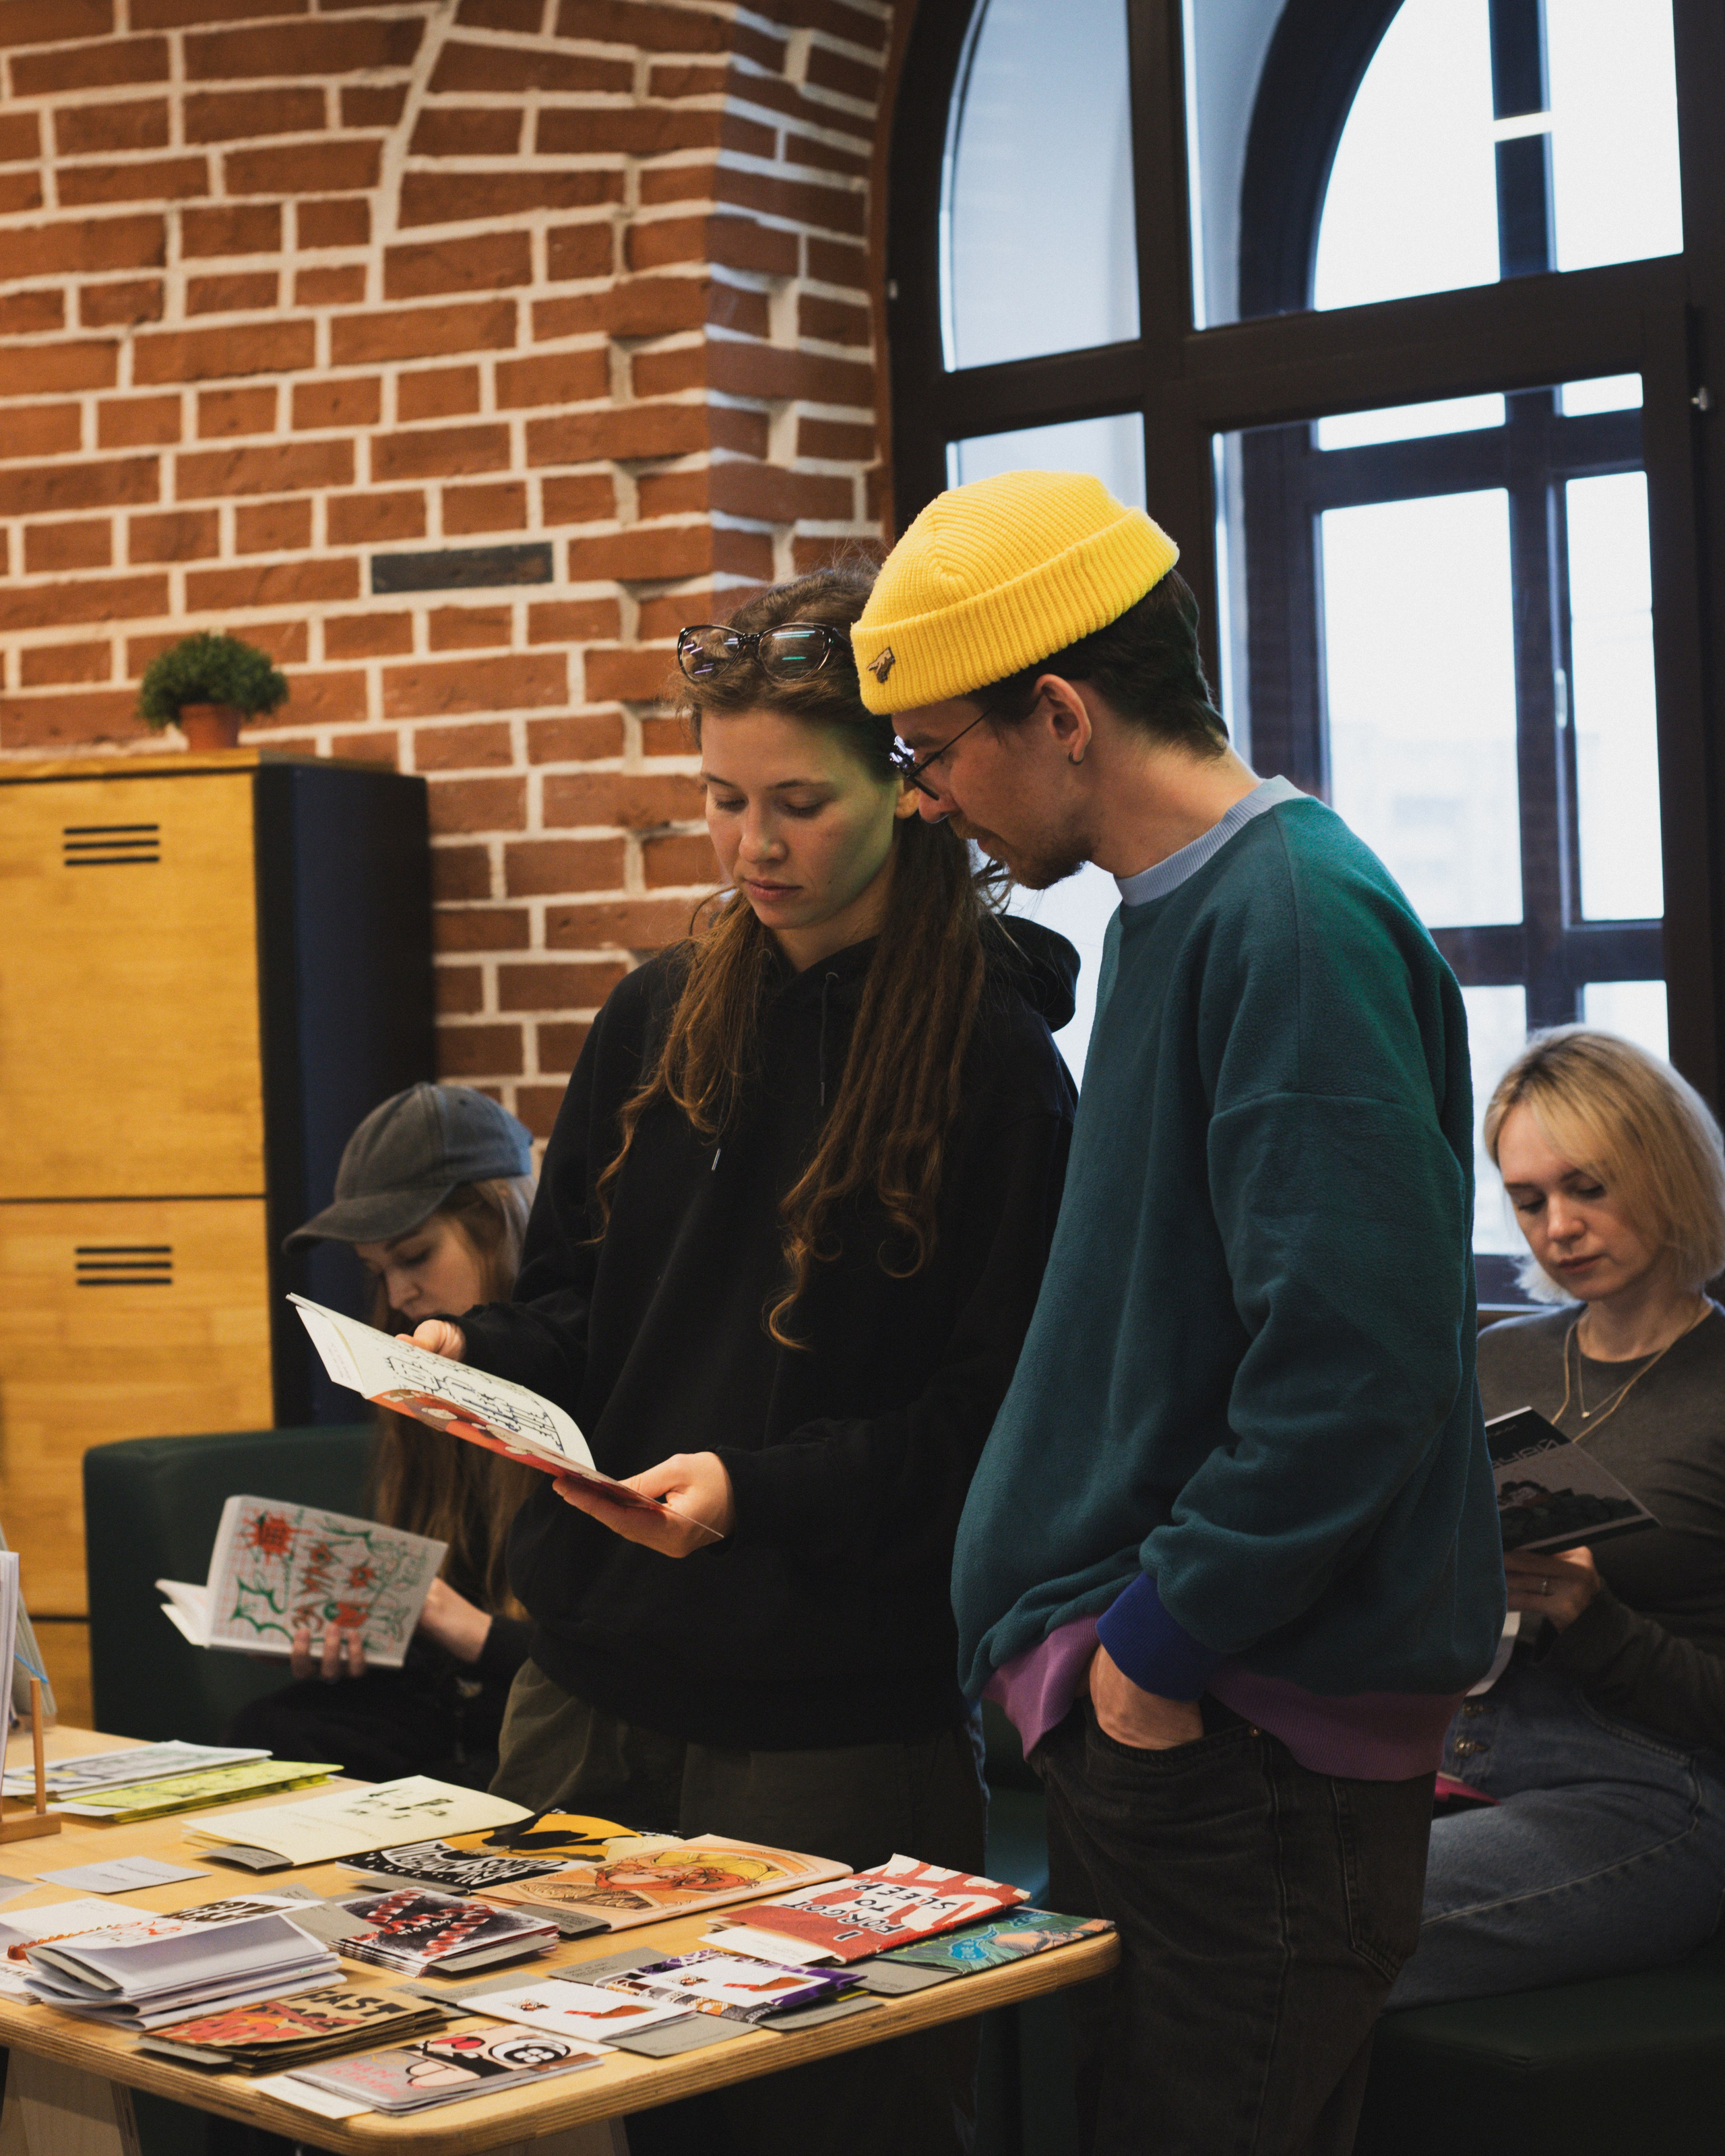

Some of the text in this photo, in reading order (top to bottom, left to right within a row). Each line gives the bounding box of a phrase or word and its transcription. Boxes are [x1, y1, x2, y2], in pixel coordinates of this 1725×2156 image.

[854, 1899, 894, 1912] TO
[780, 1901, 907, 1934] FORGOT
[834, 1930, 863, 1941] I
[288, 1990, 413, 2017] FAST
